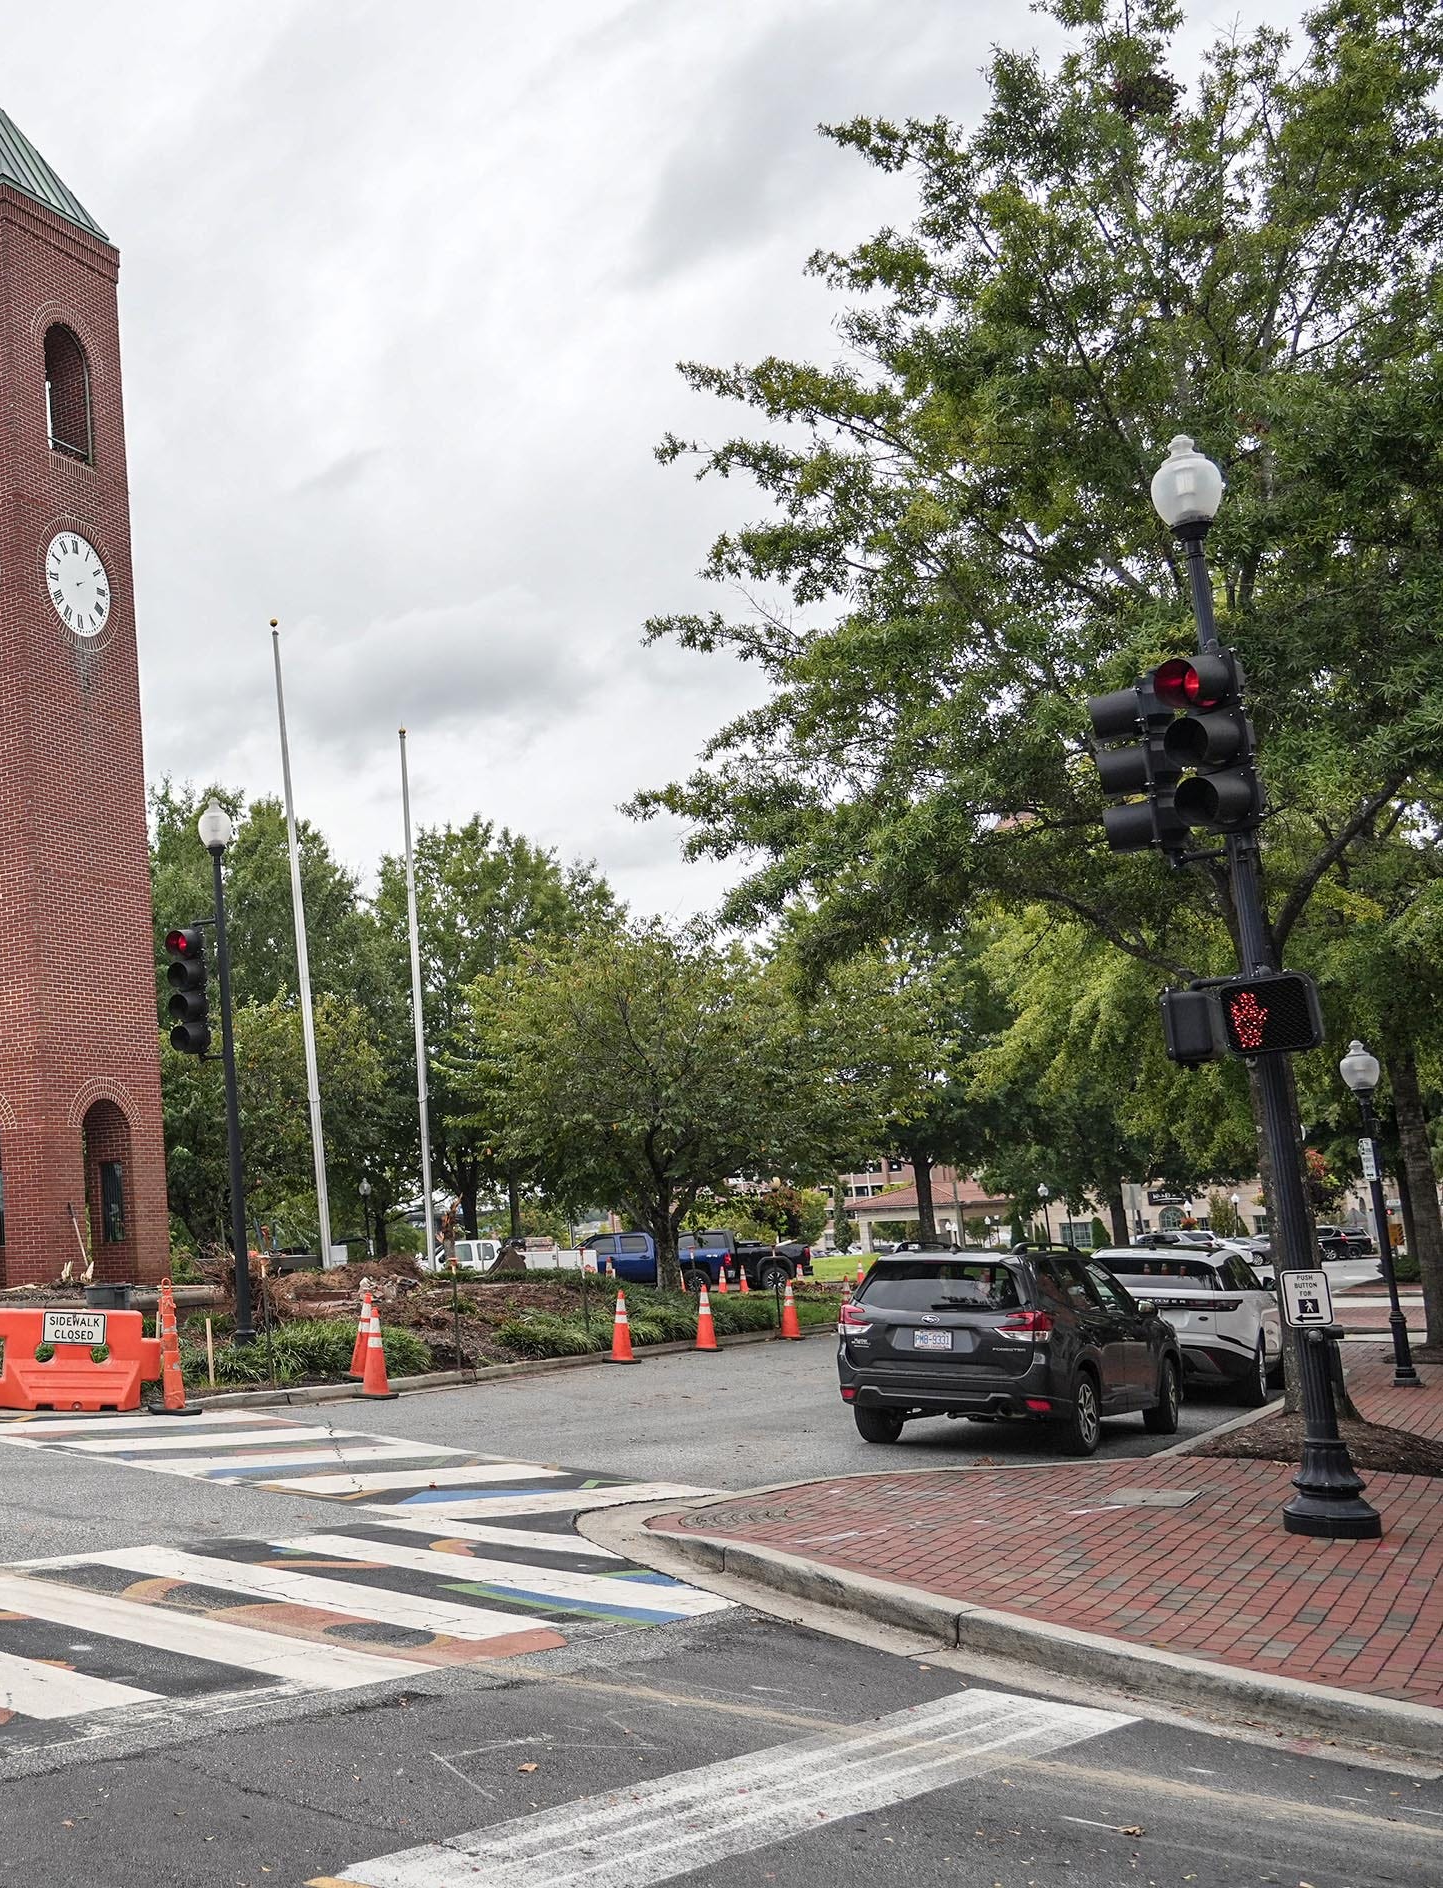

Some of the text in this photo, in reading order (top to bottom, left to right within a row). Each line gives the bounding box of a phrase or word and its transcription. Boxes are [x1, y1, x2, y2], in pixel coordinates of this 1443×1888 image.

[92, 568, 101, 577] II
[49, 1316, 100, 1327] SIDEWALK
[54, 1329, 94, 1340] CLOSED
